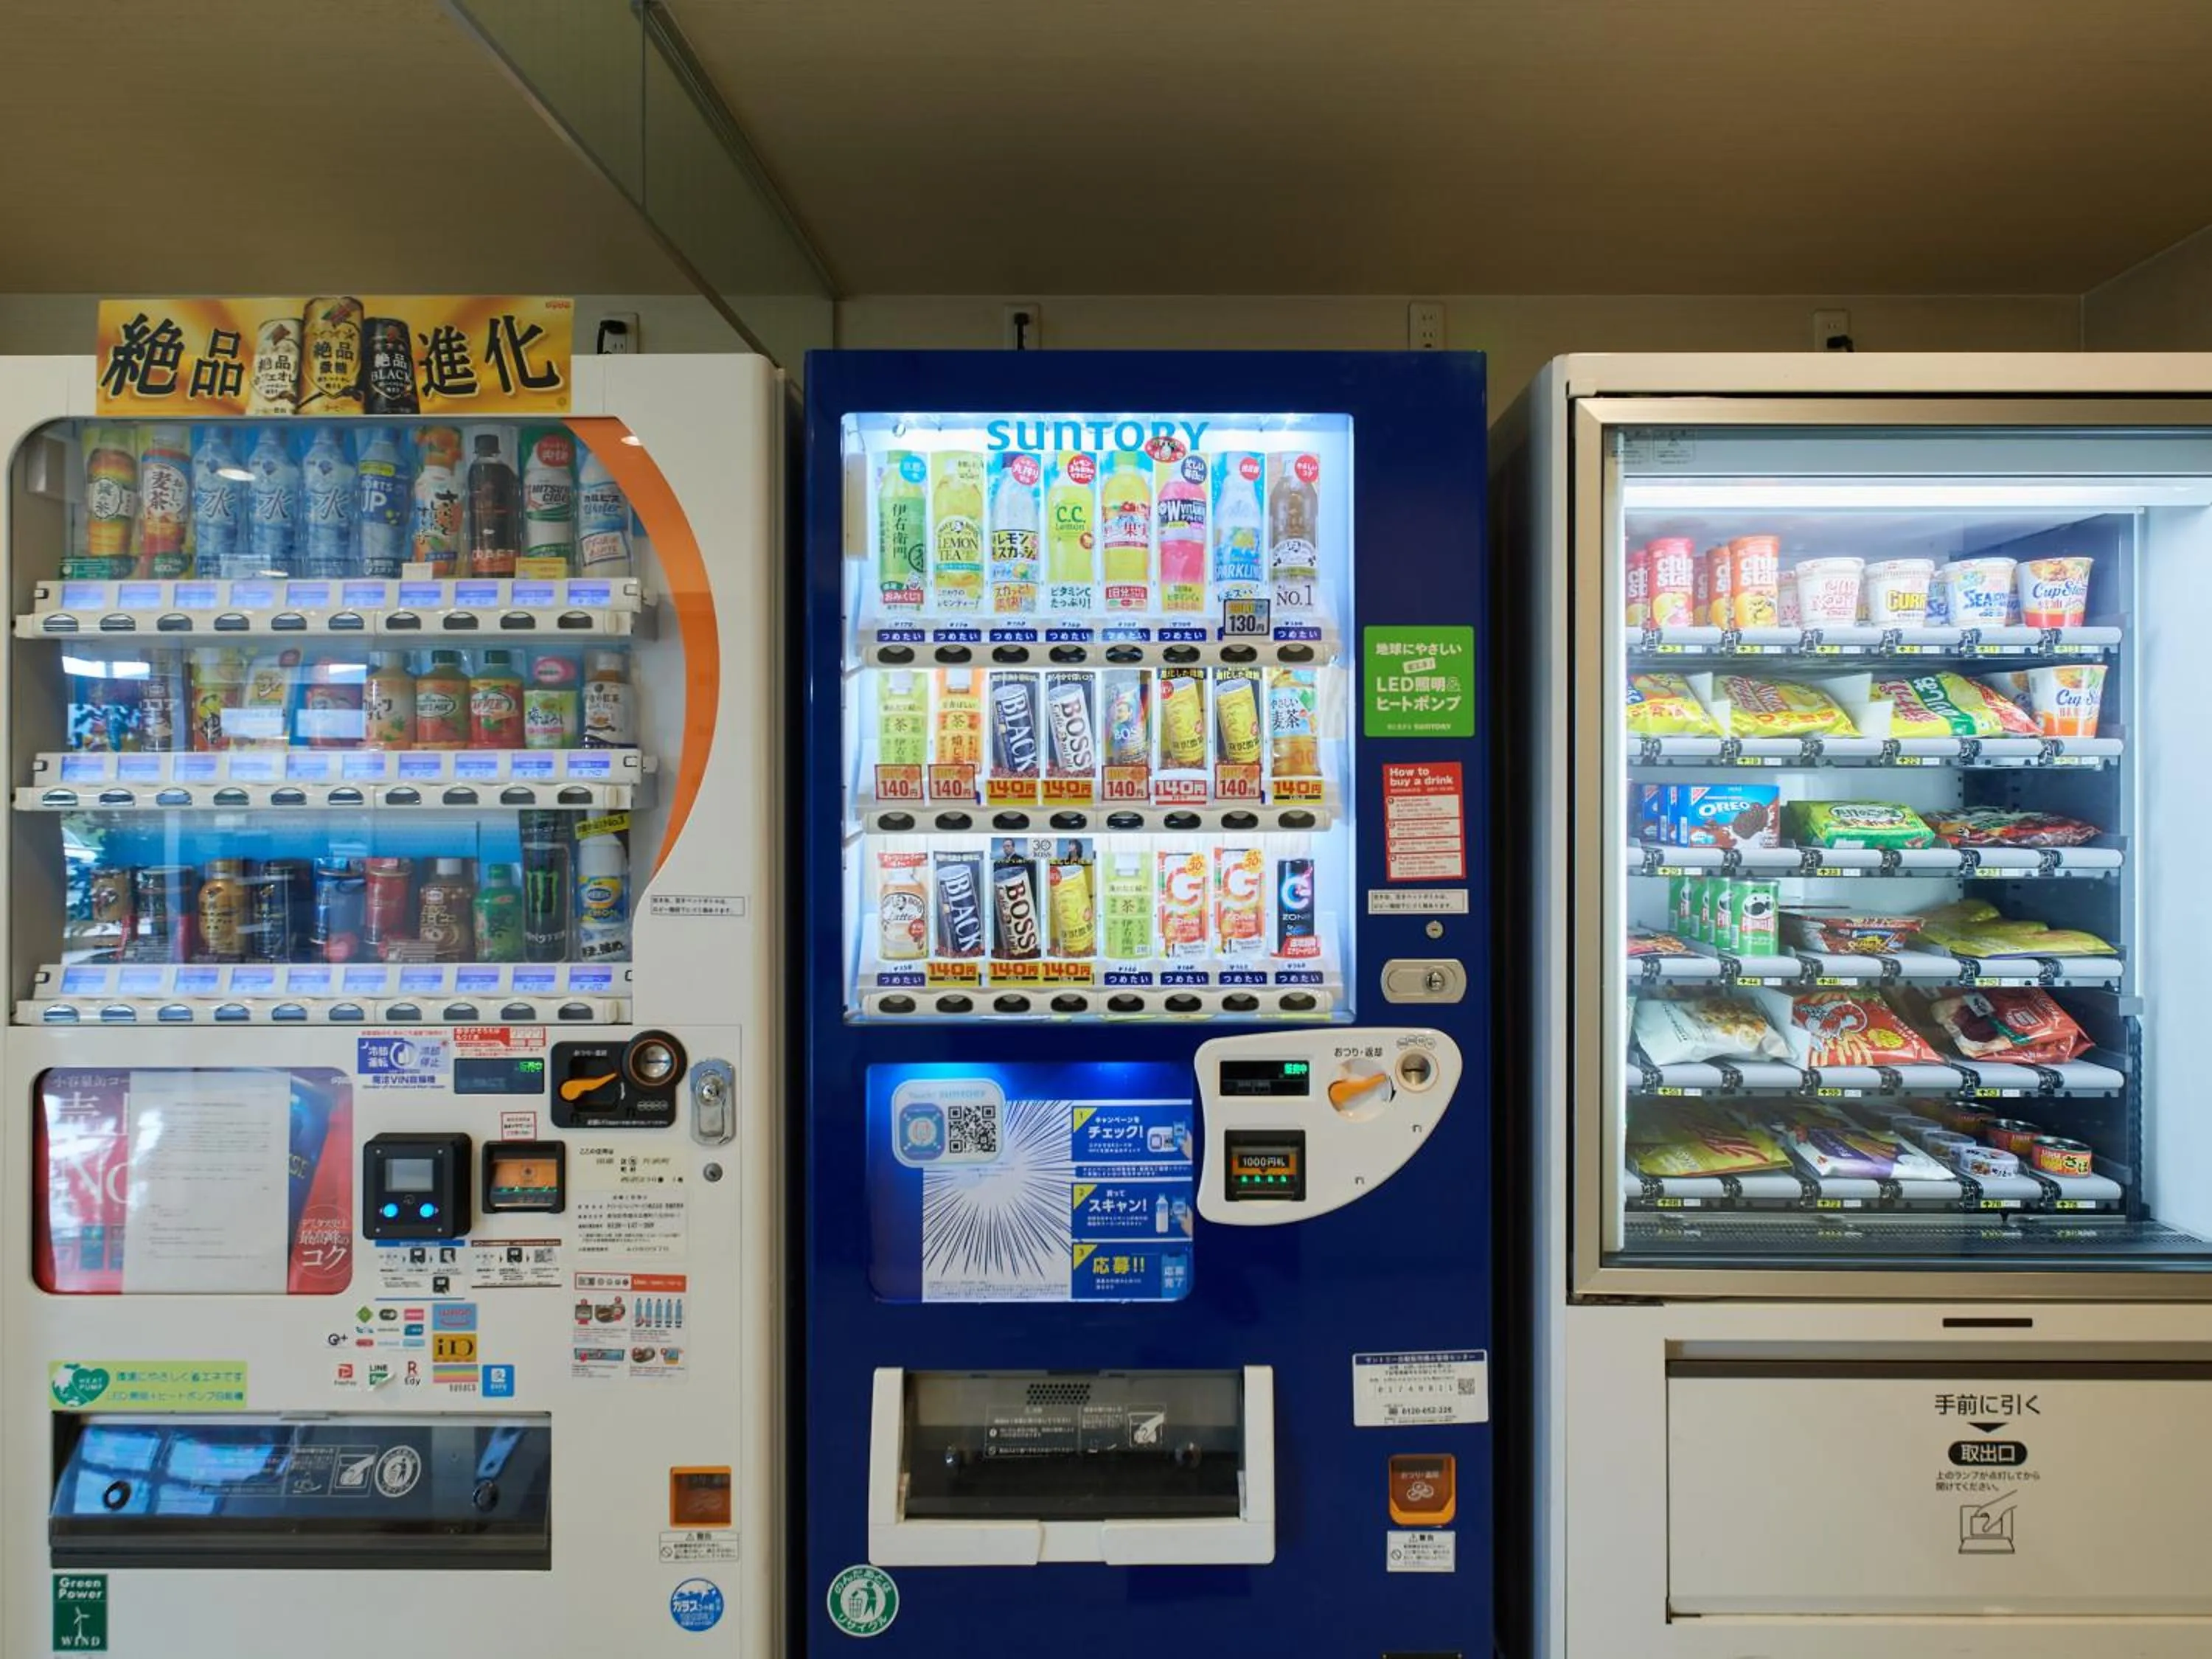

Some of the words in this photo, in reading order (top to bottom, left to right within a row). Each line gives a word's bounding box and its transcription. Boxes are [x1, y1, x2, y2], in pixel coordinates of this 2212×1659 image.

[100, 313, 245, 397] 絶品
[418, 315, 561, 397] 進化
[200, 489, 232, 518] 水
[259, 489, 288, 519] 水
[316, 488, 348, 518] 水
[1056, 507, 1087, 524] C.C.
[938, 537, 978, 550] LEMON
[1276, 586, 1314, 606] NO.1
[1229, 615, 1265, 633] 130円
[880, 632, 922, 641] つめたい
[937, 632, 978, 641] つめたい
[993, 632, 1034, 641] つめたい
[1049, 632, 1090, 641] つめたい
[1107, 630, 1147, 640] つめたい
[1161, 630, 1203, 639] つめたい
[1277, 629, 1318, 639] つめたい
[1376, 642, 1463, 655] 地球にやさしい
[1377, 695, 1462, 712] ヒートポンプ
[1272, 709, 1300, 730] 麦茶
[1001, 693, 1037, 772] BLACK
[1061, 700, 1092, 768] BOSS
[1390, 767, 1414, 776] How
[1418, 767, 1430, 775] to
[880, 780, 918, 797] 140円
[934, 780, 972, 797] 140円
[988, 780, 1037, 794] 140円
[1043, 781, 1092, 795] 140円
[1155, 781, 1206, 796] 140円
[1219, 780, 1256, 796] 140円
[1274, 781, 1322, 794] 140円
[1390, 778, 1411, 787] buy
[1424, 776, 1453, 785] drink
[1107, 782, 1144, 797] 140円
[1698, 801, 1750, 817] OREO
[945, 872, 982, 952] BLACK
[1006, 879, 1037, 953] BOSS
[928, 963, 978, 975] 140円
[990, 963, 1038, 975] 140円
[1042, 963, 1090, 975] 140円
[881, 975, 922, 984] つめたい
[1108, 974, 1149, 984] つめたい
[1164, 974, 1206, 984] つめたい
[1222, 974, 1263, 984] つめたい
[1279, 974, 1319, 984] つめたい
[1088, 1125, 1144, 1139] チェック!
[1088, 1198, 1147, 1213] スキャン!
[302, 1245, 347, 1270] コク
[369, 1364, 388, 1372] LINE
[1934, 1394, 2041, 1416] 手前に引く
[1961, 1444, 2016, 1463] 取出口
[59, 1576, 102, 1587] Green
[58, 1588, 103, 1599] Power
[61, 1635, 101, 1646] WIND
